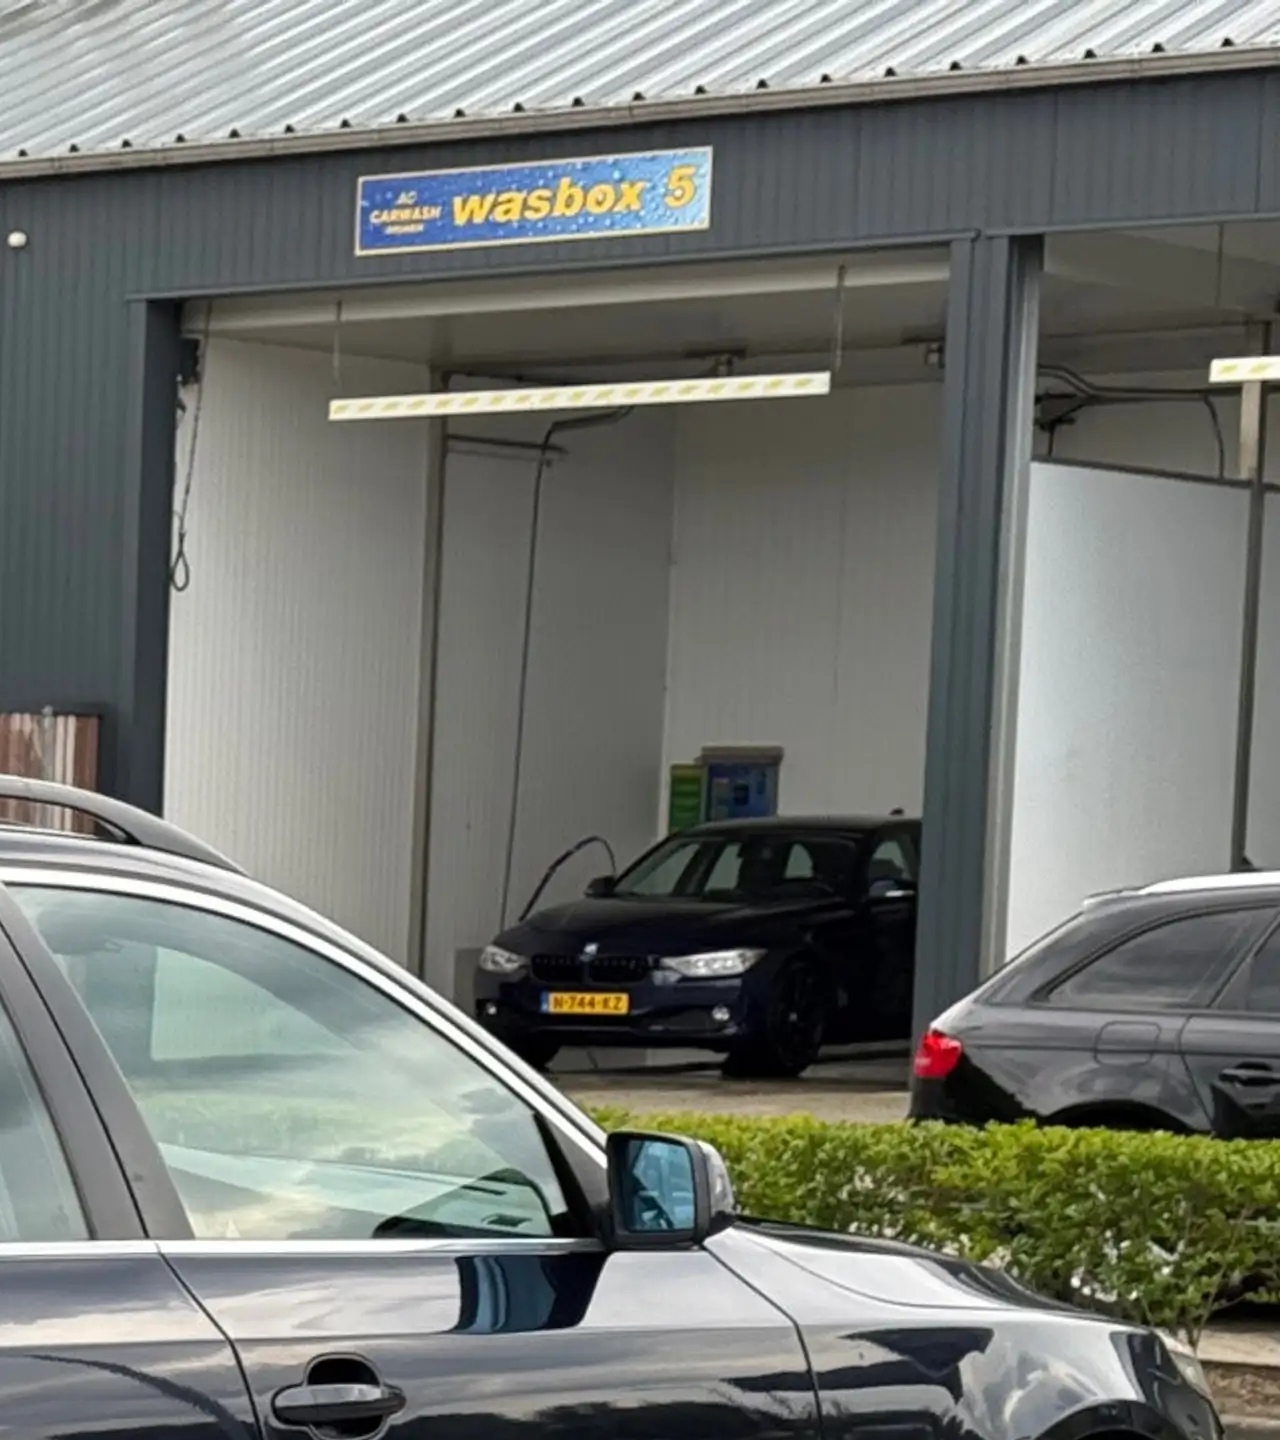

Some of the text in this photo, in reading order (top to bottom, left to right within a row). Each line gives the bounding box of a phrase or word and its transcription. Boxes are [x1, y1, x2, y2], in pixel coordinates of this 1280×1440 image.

[451, 166, 697, 226] wasbox 5
[552, 995, 624, 1011] N-744-KZ
